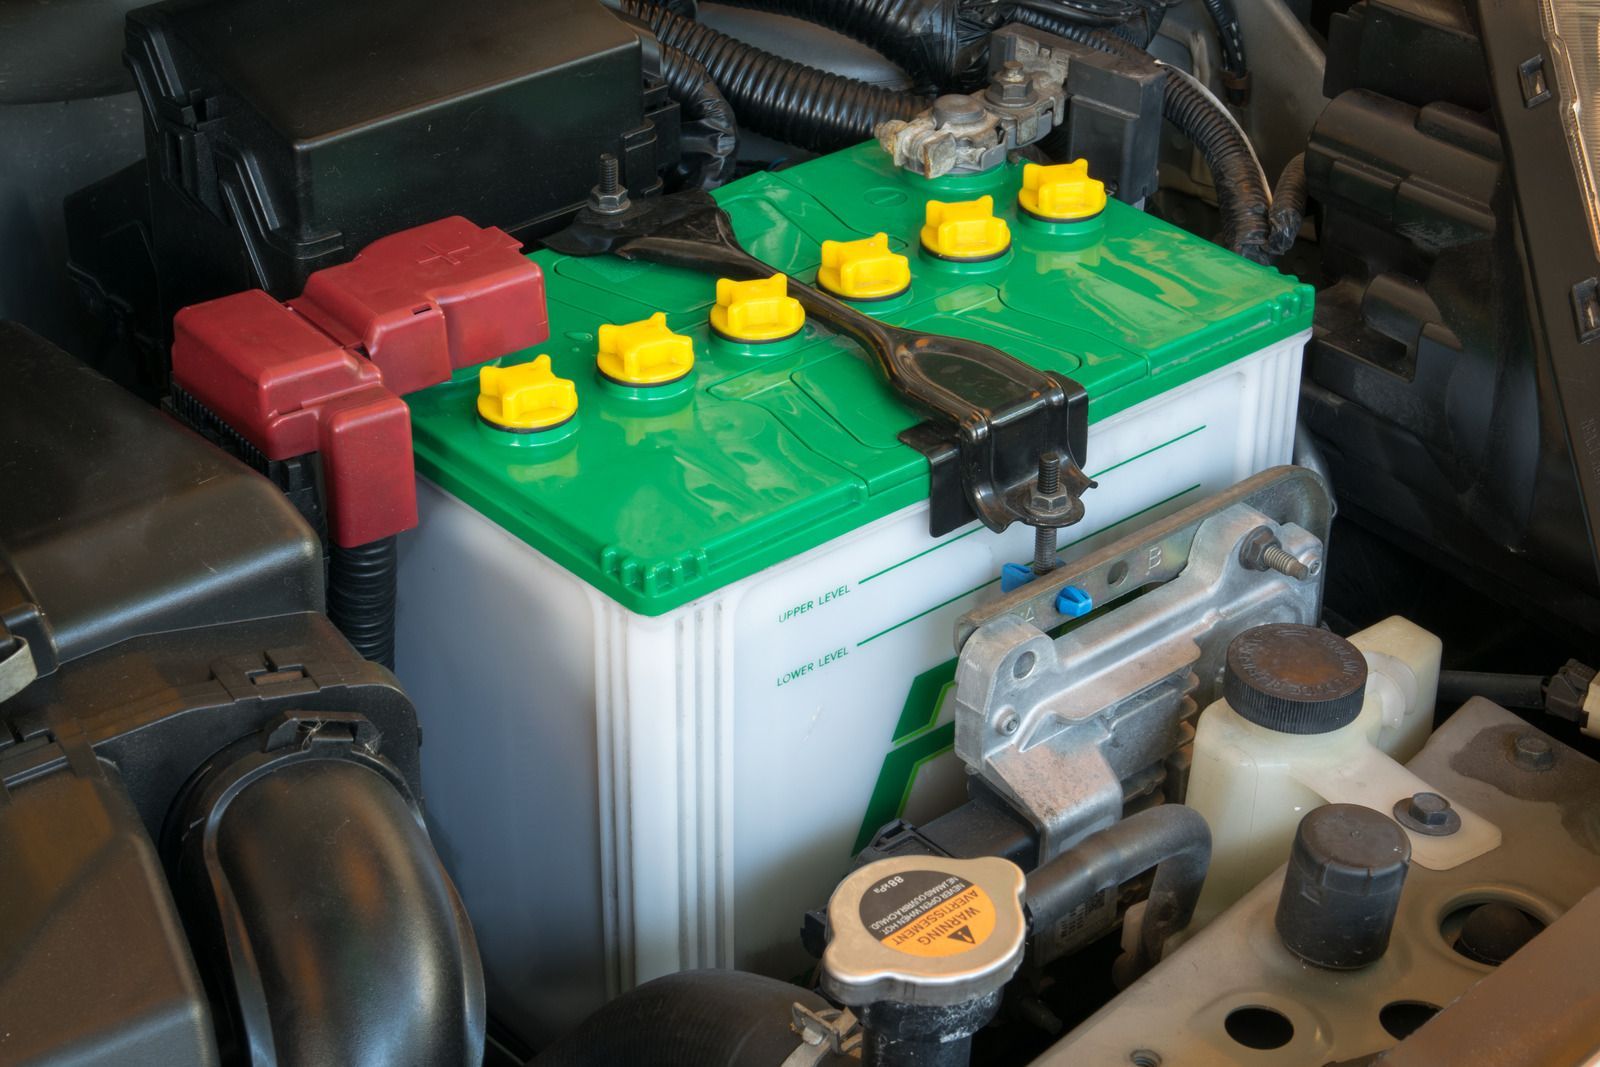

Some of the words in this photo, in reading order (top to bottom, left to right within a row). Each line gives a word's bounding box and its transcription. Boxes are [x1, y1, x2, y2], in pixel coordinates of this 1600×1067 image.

[778, 600, 814, 623] UPPER
[819, 584, 851, 606] LEVEL
[776, 662, 814, 687] LOWER
[819, 647, 849, 668] LEVEL
[918, 895, 943, 911] OPEN
[940, 882, 965, 899] NEVER
[891, 889, 979, 945] AVERTISSEMENT
[896, 908, 922, 925] WHEN
[917, 906, 981, 946] WARNING
